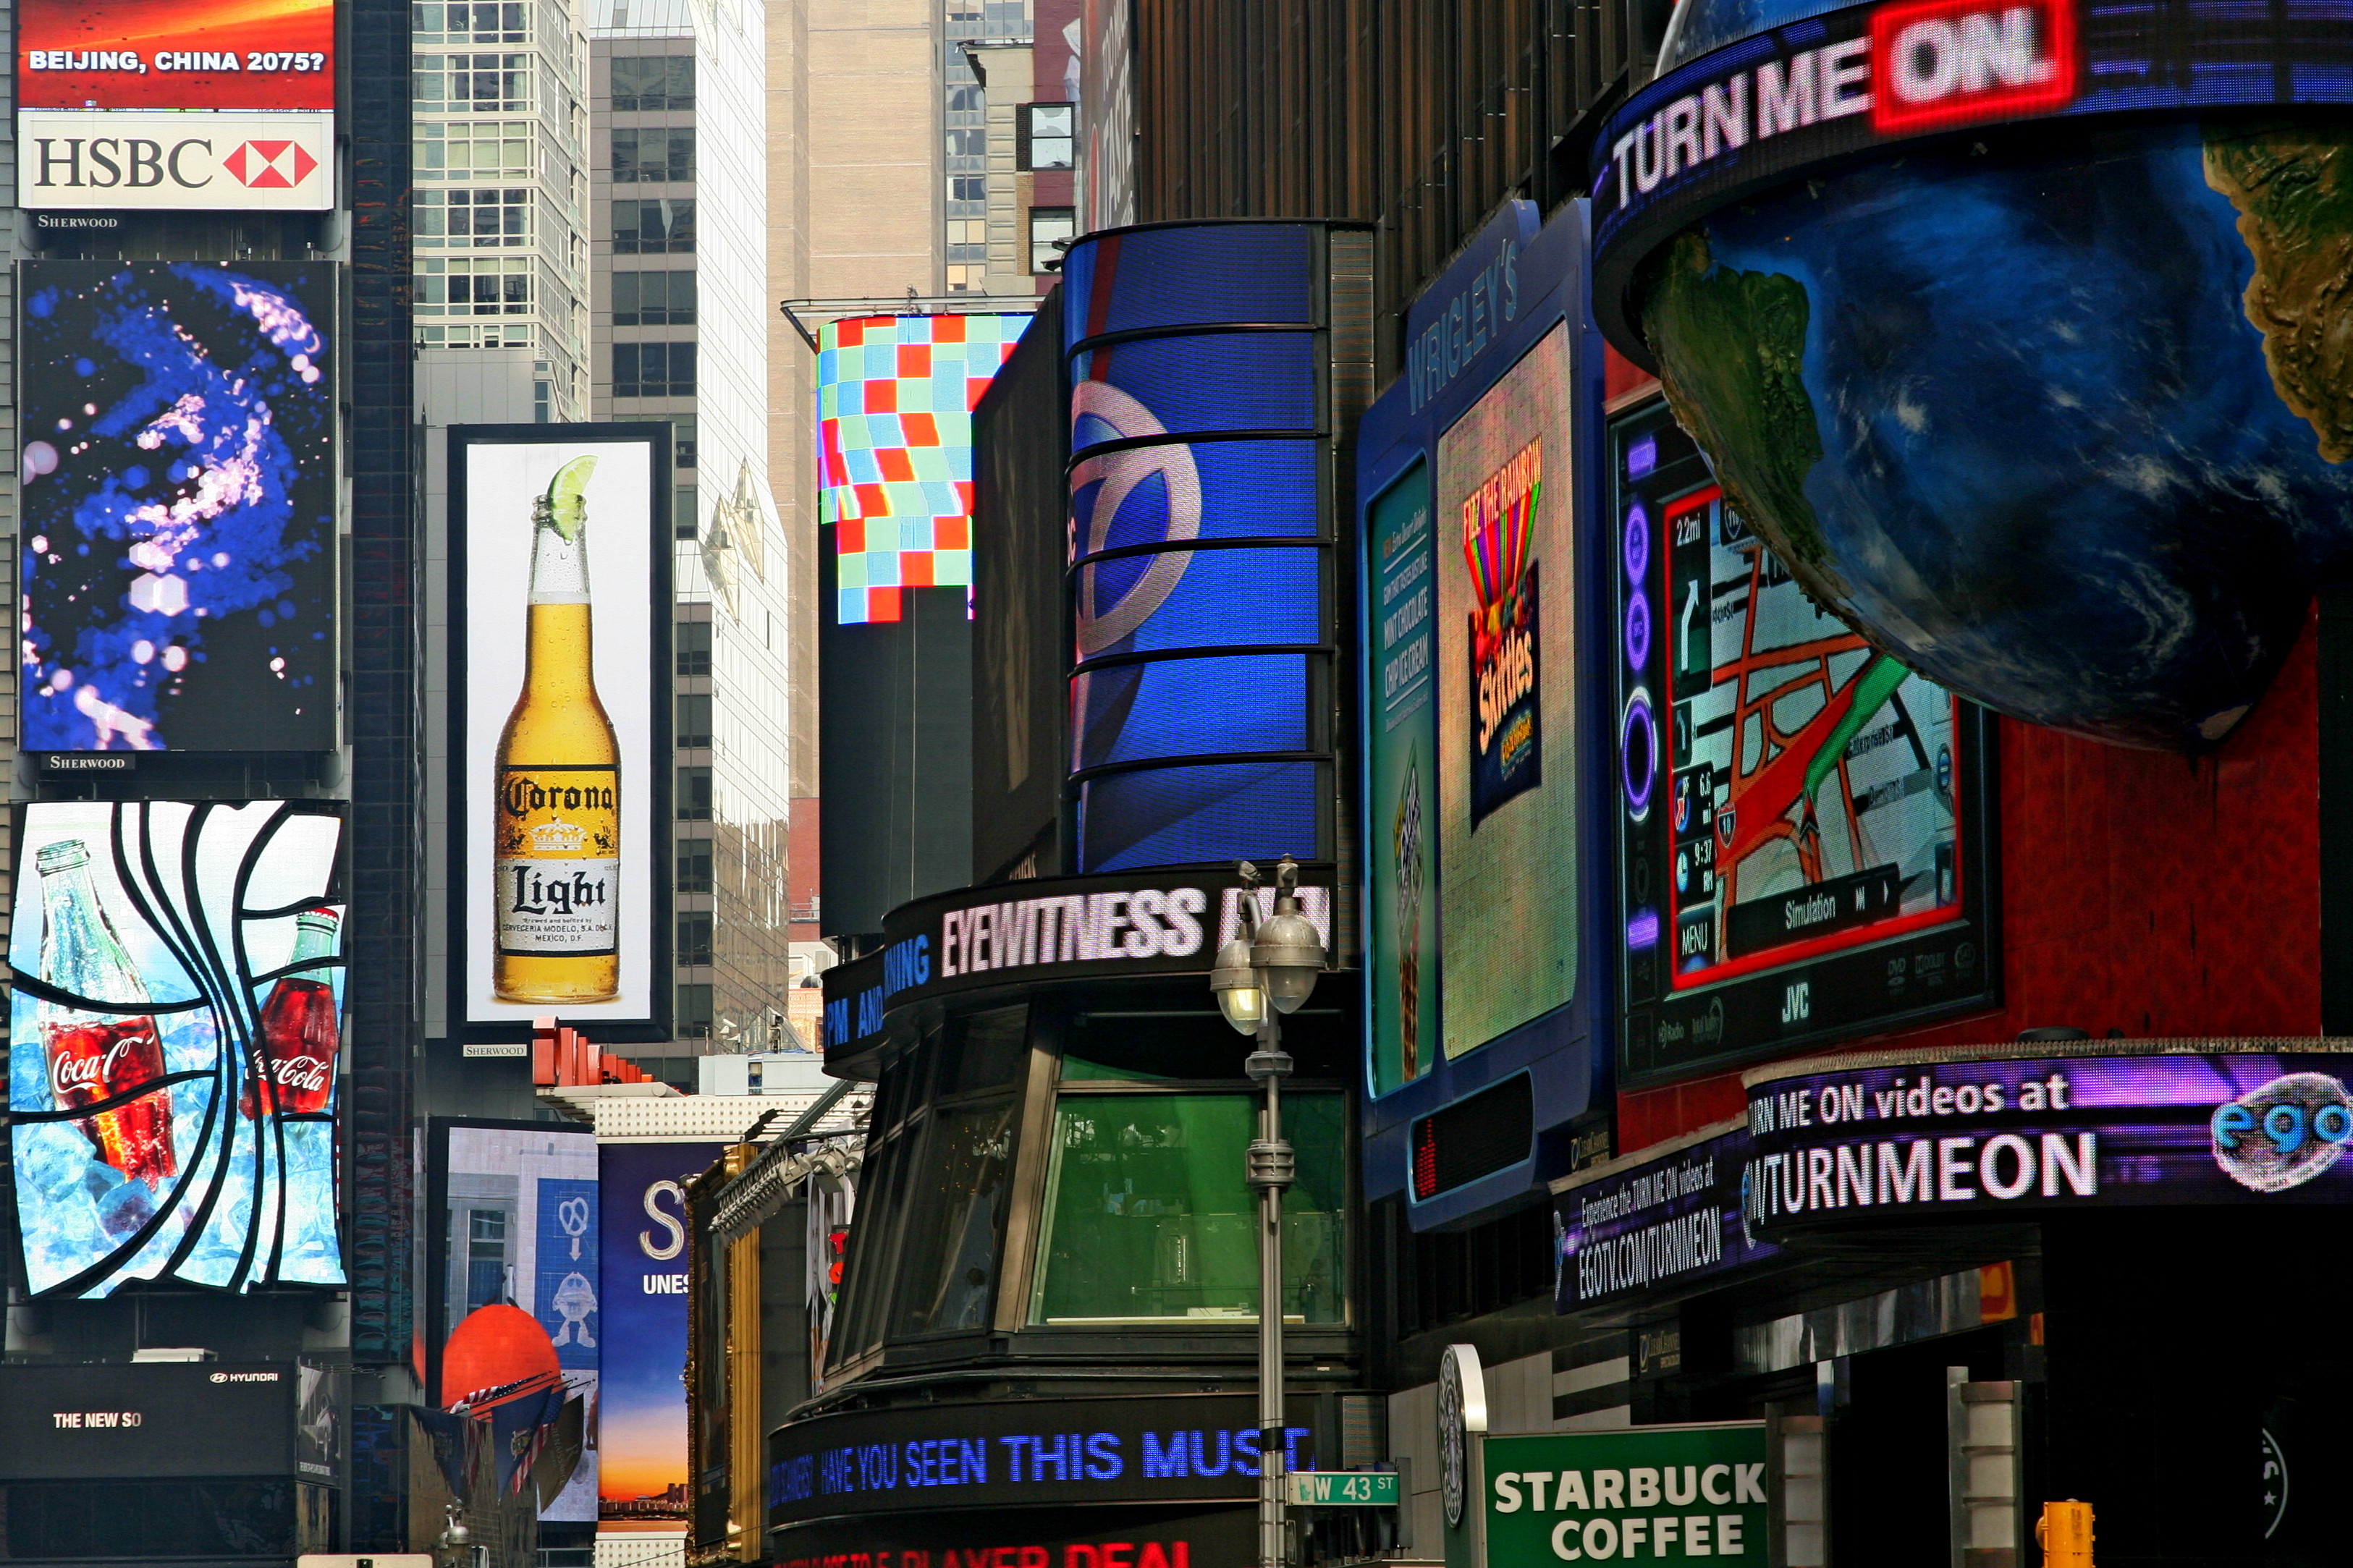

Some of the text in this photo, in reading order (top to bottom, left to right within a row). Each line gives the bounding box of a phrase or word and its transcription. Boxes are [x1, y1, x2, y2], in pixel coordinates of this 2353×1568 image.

[30, 51, 324, 74] BEIJING, CHINA 2075?
[1613, 71, 1749, 210] TURN
[1757, 35, 1877, 140] ME
[34, 137, 214, 188] HSBC
[1408, 238, 1518, 415] WRIGLEY'S
[1482, 475, 1500, 528] THE
[1501, 435, 1542, 512] RAINBOW
[1384, 585, 1428, 651] MINT CHOCOLATE
[1385, 658, 1398, 699] CHIP
[1408, 632, 1428, 682] CREAM
[505, 776, 614, 821] Corona
[1699, 771, 1711, 797] 6.6
[1694, 838, 1712, 867] 9:37
[511, 865, 607, 915] Light
[1785, 896, 1836, 931] Simulation
[942, 888, 1207, 977] EYEWITNESS
[1682, 923, 1708, 956] MENU
[858, 985, 884, 1038] AND
[1783, 982, 1809, 1025] JVC
[1780, 1090, 1812, 1130] ME
[1820, 1084, 1865, 1124] ON
[1875, 1075, 2006, 1119] videos
[2019, 1073, 2070, 1111] at
[2212, 1103, 2352, 1153] ego
[1582, 1190, 1618, 1233] Experience
[1619, 1182, 1631, 1216] the
[1633, 1175, 1652, 1211] TURN
[1653, 1170, 1665, 1205] ME
[1666, 1166, 1678, 1200] ON
[1678, 1158, 1704, 1195] videos
[1704, 1156, 1714, 1187] at
[1579, 1204, 1721, 1300] EGOTV.COM/TURNMEON
[229, 1373, 279, 1383] HYUNDAI
[54, 1412, 141, 1428] THE NEW SO
[821, 1446, 854, 1494] HAVE
[856, 1444, 897, 1490] YOU
[905, 1436, 987, 1488] SEEN
[998, 1431, 1125, 1481] THIS
[1314, 1476, 1393, 1501] W 43 ST
[1551, 1514, 1745, 1561] COFFEE
